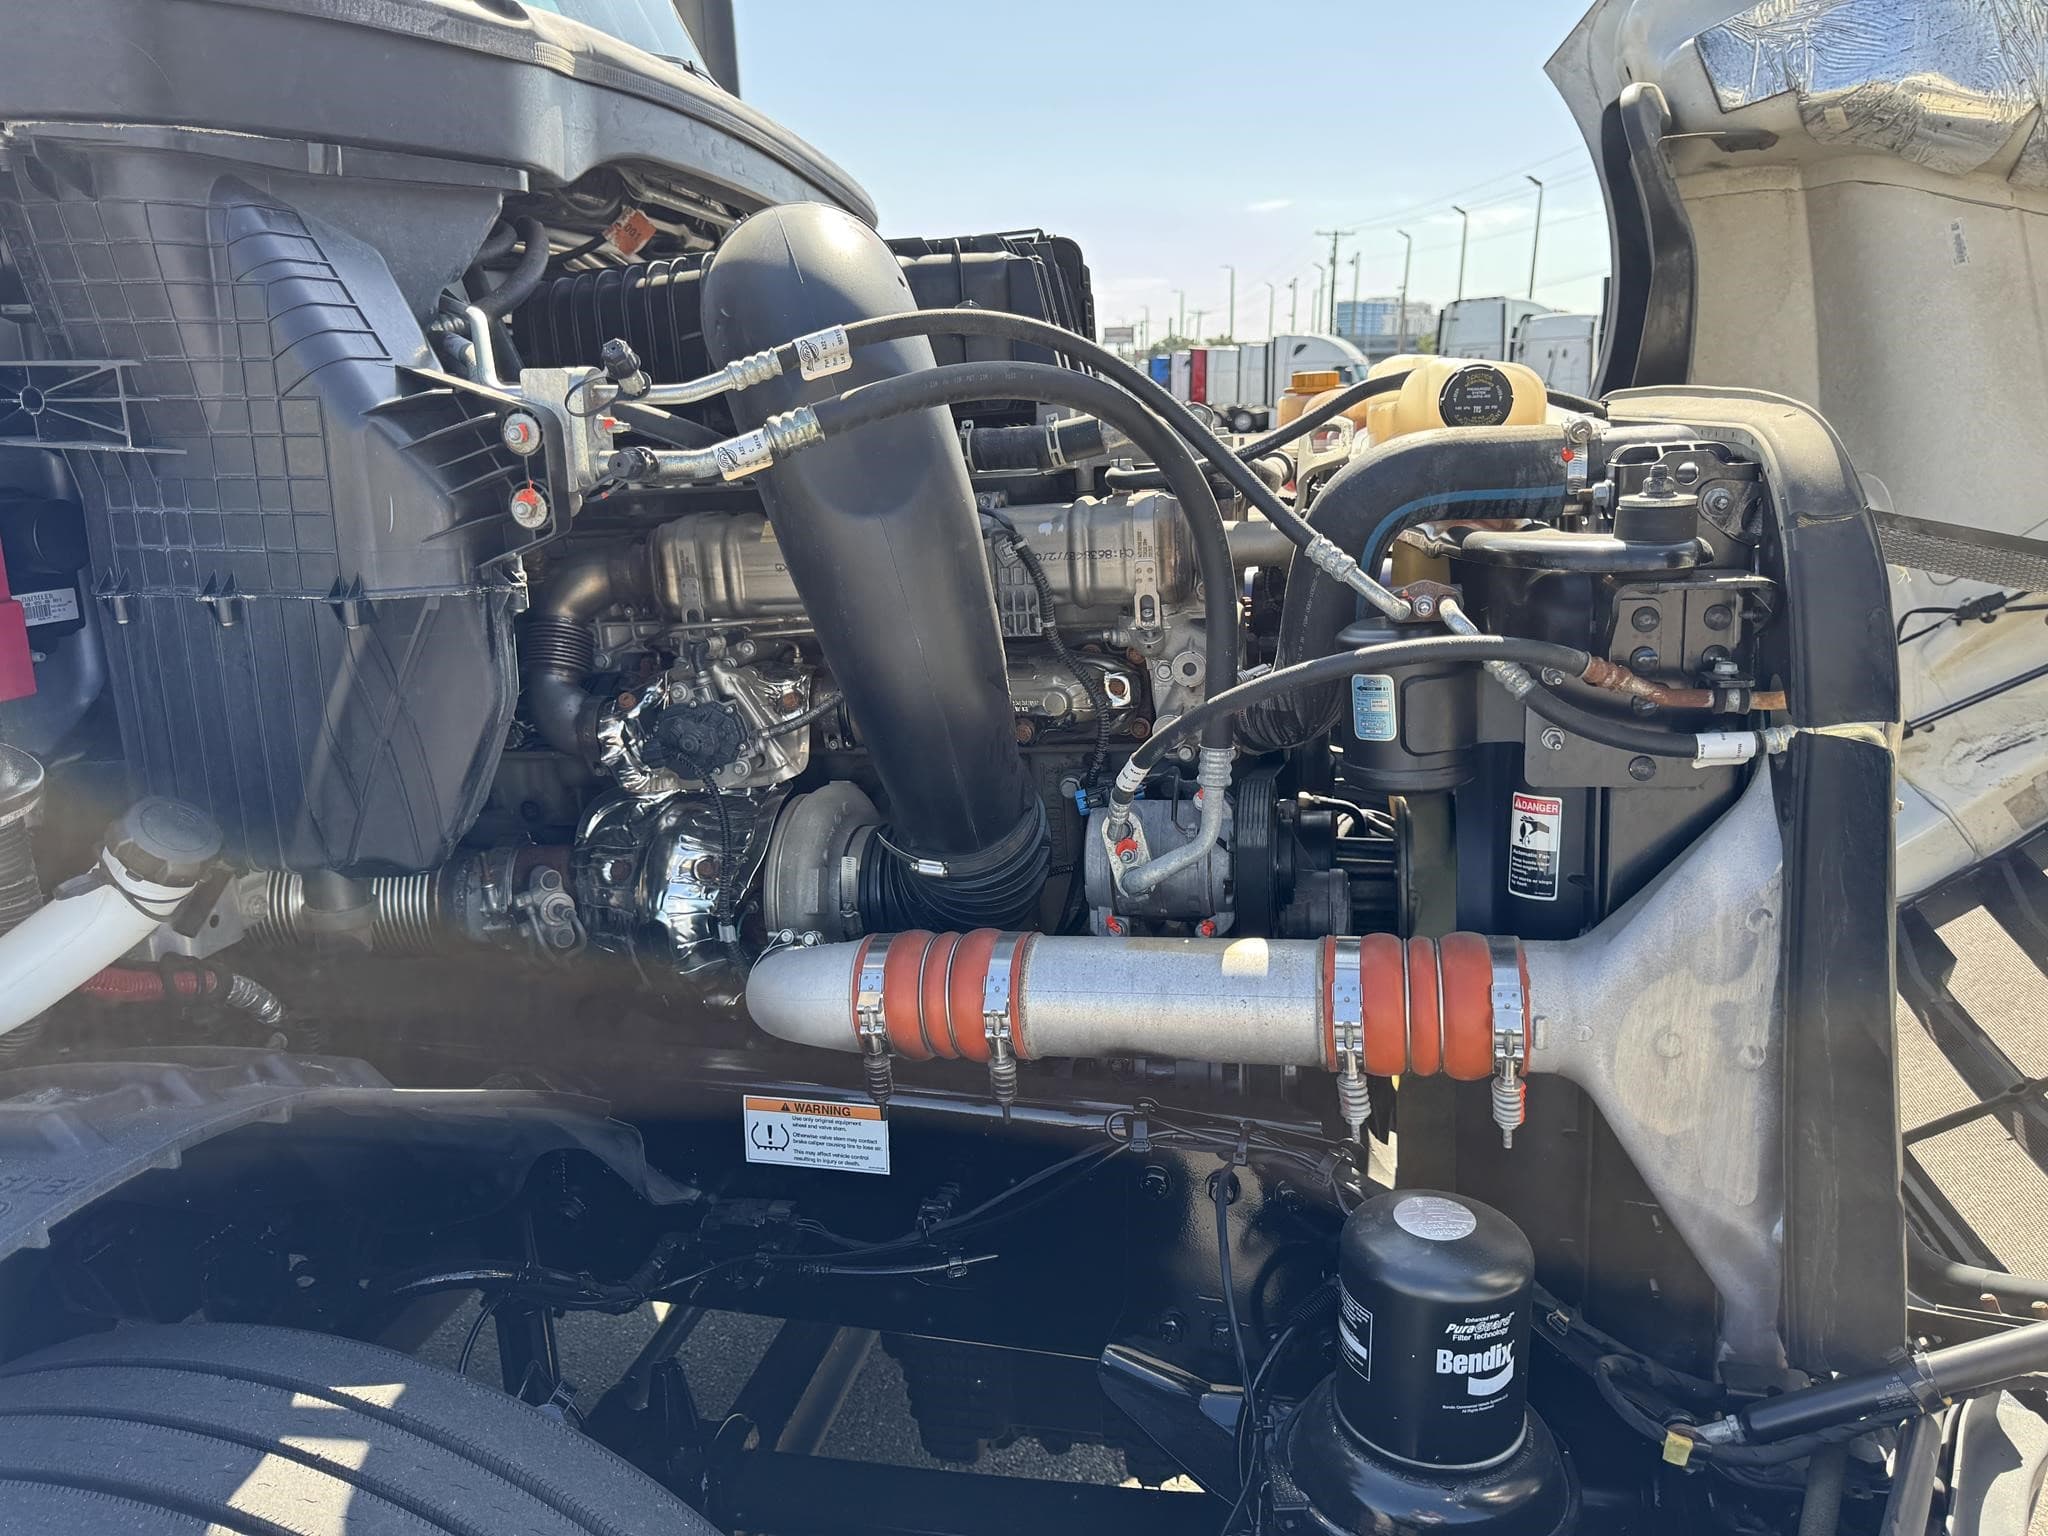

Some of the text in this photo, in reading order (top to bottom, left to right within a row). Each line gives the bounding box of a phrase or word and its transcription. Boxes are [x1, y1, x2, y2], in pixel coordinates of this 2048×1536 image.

[1522, 800, 1558, 813] DANGER
[794, 1103, 850, 1116] WARNING
[1473, 1327, 1509, 1340] Technology
[1436, 1343, 1512, 1374] Bendix
